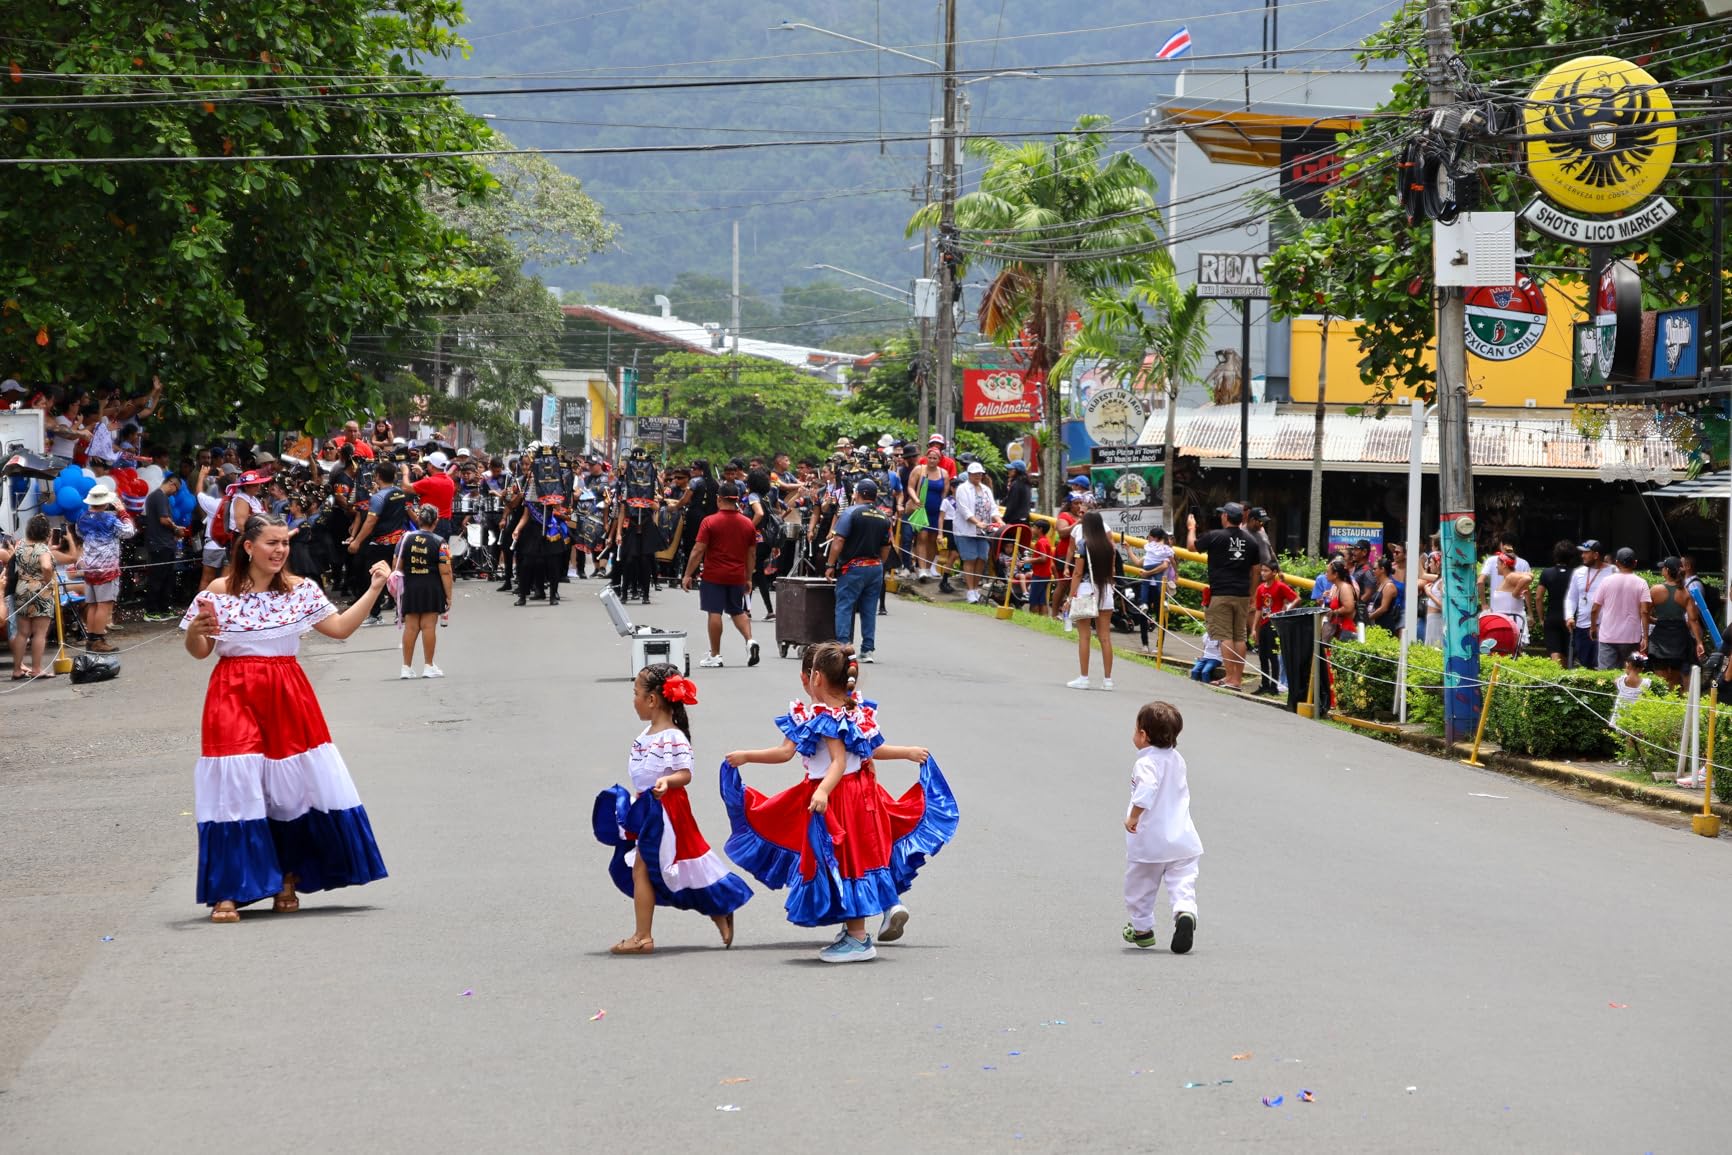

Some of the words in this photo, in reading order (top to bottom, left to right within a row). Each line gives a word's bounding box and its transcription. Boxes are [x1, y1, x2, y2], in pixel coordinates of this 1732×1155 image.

[1564, 183, 1593, 199] CERVEZA
[1608, 190, 1629, 200] COSTA
[1631, 179, 1646, 191] RICA
[1536, 207, 1579, 237] SHOTS
[1585, 224, 1615, 241] LICO
[1618, 202, 1669, 238] MARKET
[1202, 286, 1214, 295] BAR
[1465, 327, 1505, 357] MEXICAN
[1508, 331, 1540, 355] GRILL
[1088, 392, 1114, 413] OLDEST
[1117, 391, 1127, 399] IN
[1128, 398, 1142, 416] JACO
[1099, 449, 1116, 457] Best
[1117, 448, 1134, 456] Pizza
[1142, 447, 1162, 455] Town!
[1119, 510, 1142, 524] Real
[1331, 527, 1381, 537] RESTAURANT
[415, 535, 426, 544] Soy
